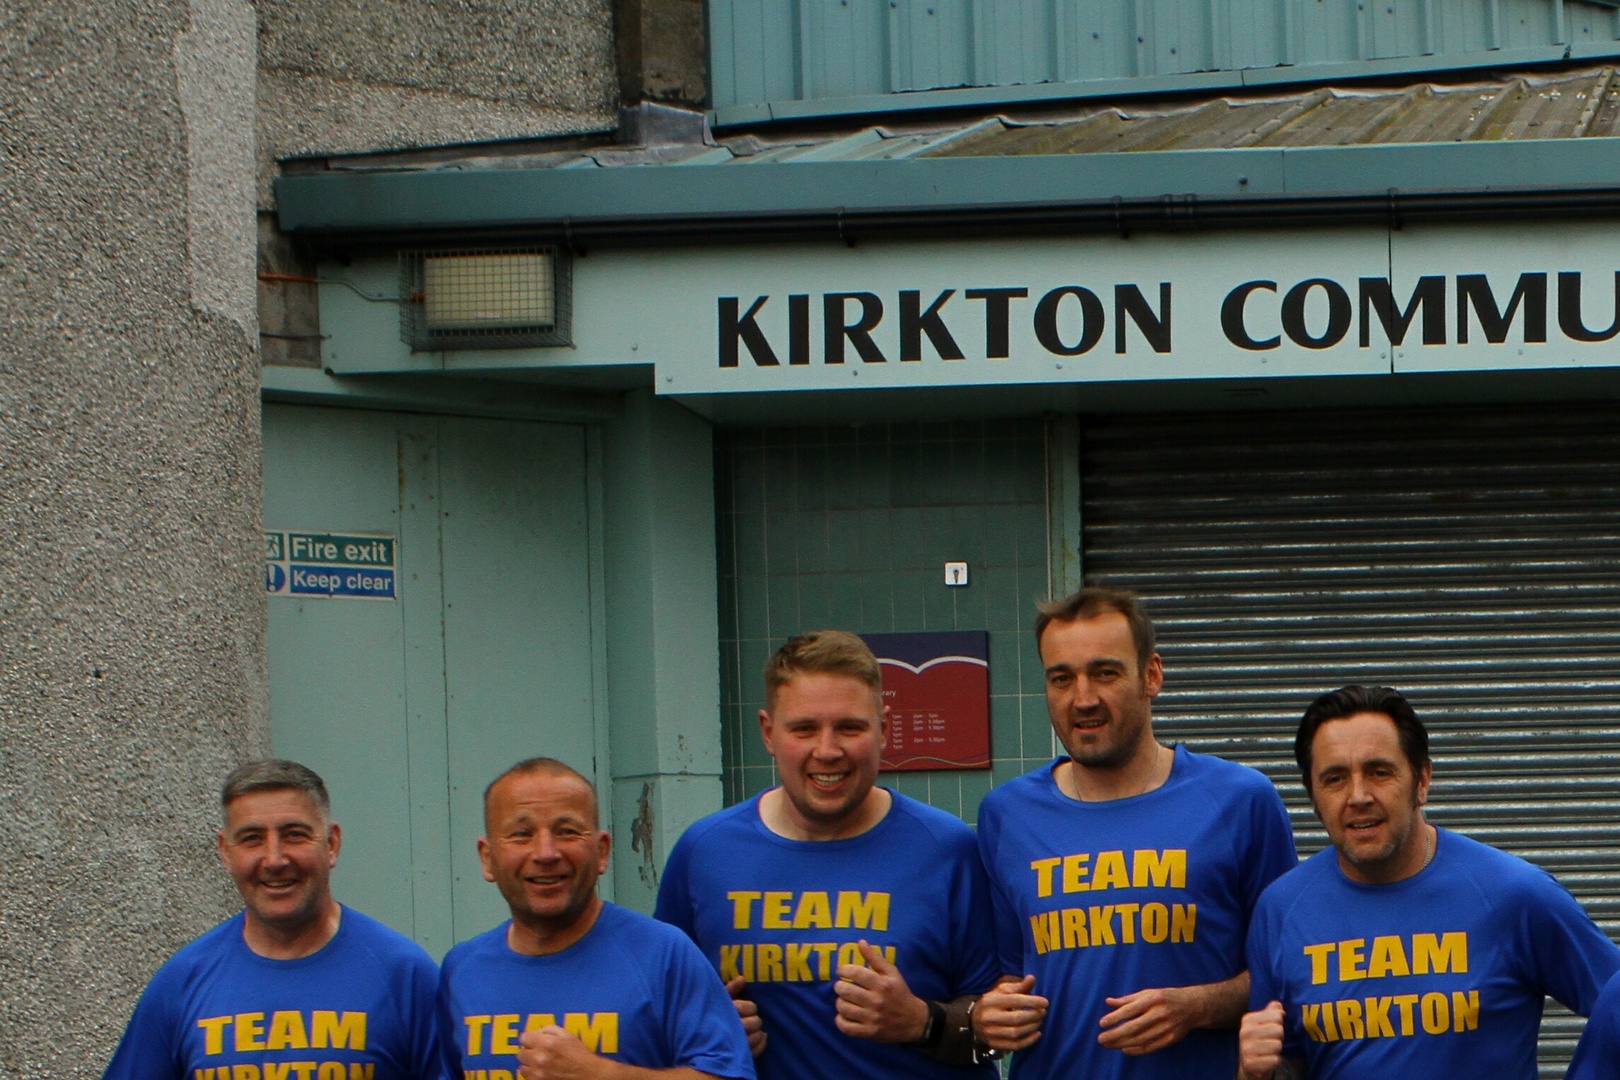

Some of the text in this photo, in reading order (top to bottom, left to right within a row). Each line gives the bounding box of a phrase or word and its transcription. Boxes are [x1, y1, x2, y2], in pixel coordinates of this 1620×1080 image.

[717, 281, 1172, 368] KIRKTON
[292, 536, 387, 562] Fire exit
[293, 569, 391, 592] Keep clear
[1030, 848, 1188, 898] TEAM
[727, 890, 891, 931] TEAM
[1029, 902, 1197, 955] KIRKTON
[1303, 931, 1469, 985] TEAM
[197, 1010, 367, 1056] TEAM
[1301, 989, 1481, 1043] KIRKTON
